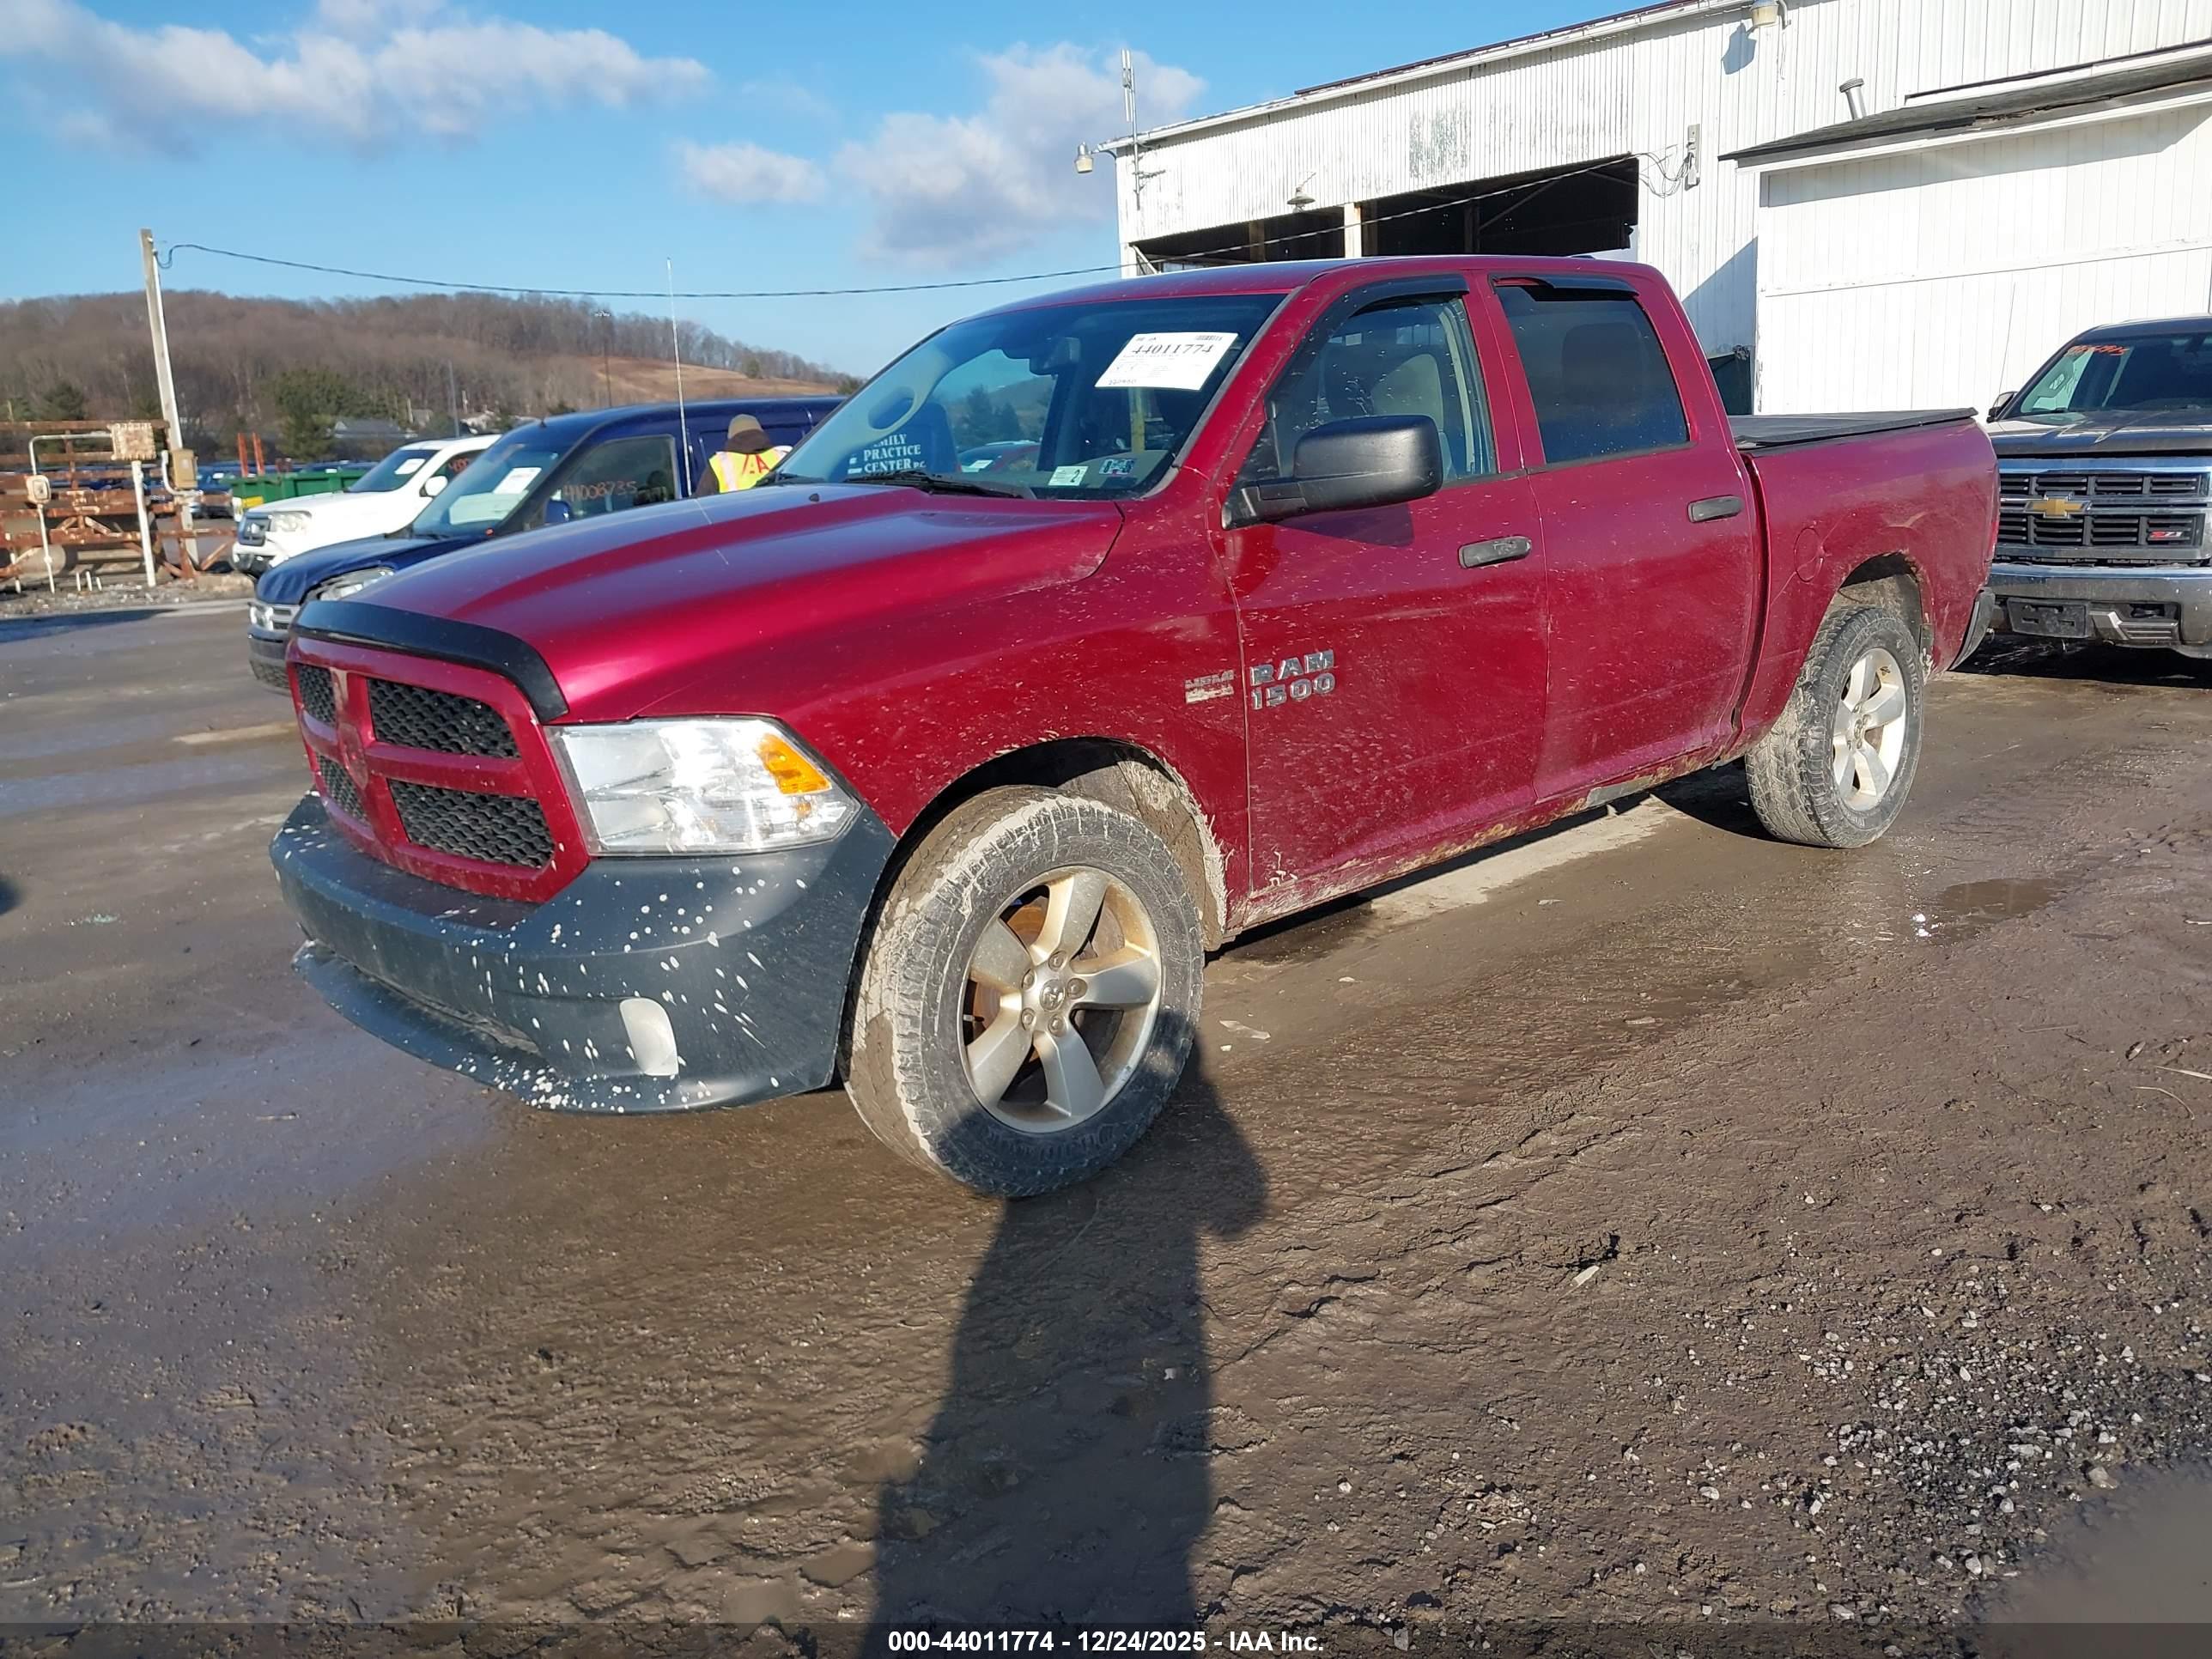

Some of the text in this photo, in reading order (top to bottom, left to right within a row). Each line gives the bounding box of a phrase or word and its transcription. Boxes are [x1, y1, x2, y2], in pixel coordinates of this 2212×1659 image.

[1132, 343, 1214, 354] 44011774
[863, 445, 921, 461] PRACTICE
[864, 459, 911, 473] CENTER
[1250, 649, 1334, 686] RAM
[1251, 672, 1335, 710] 1500
